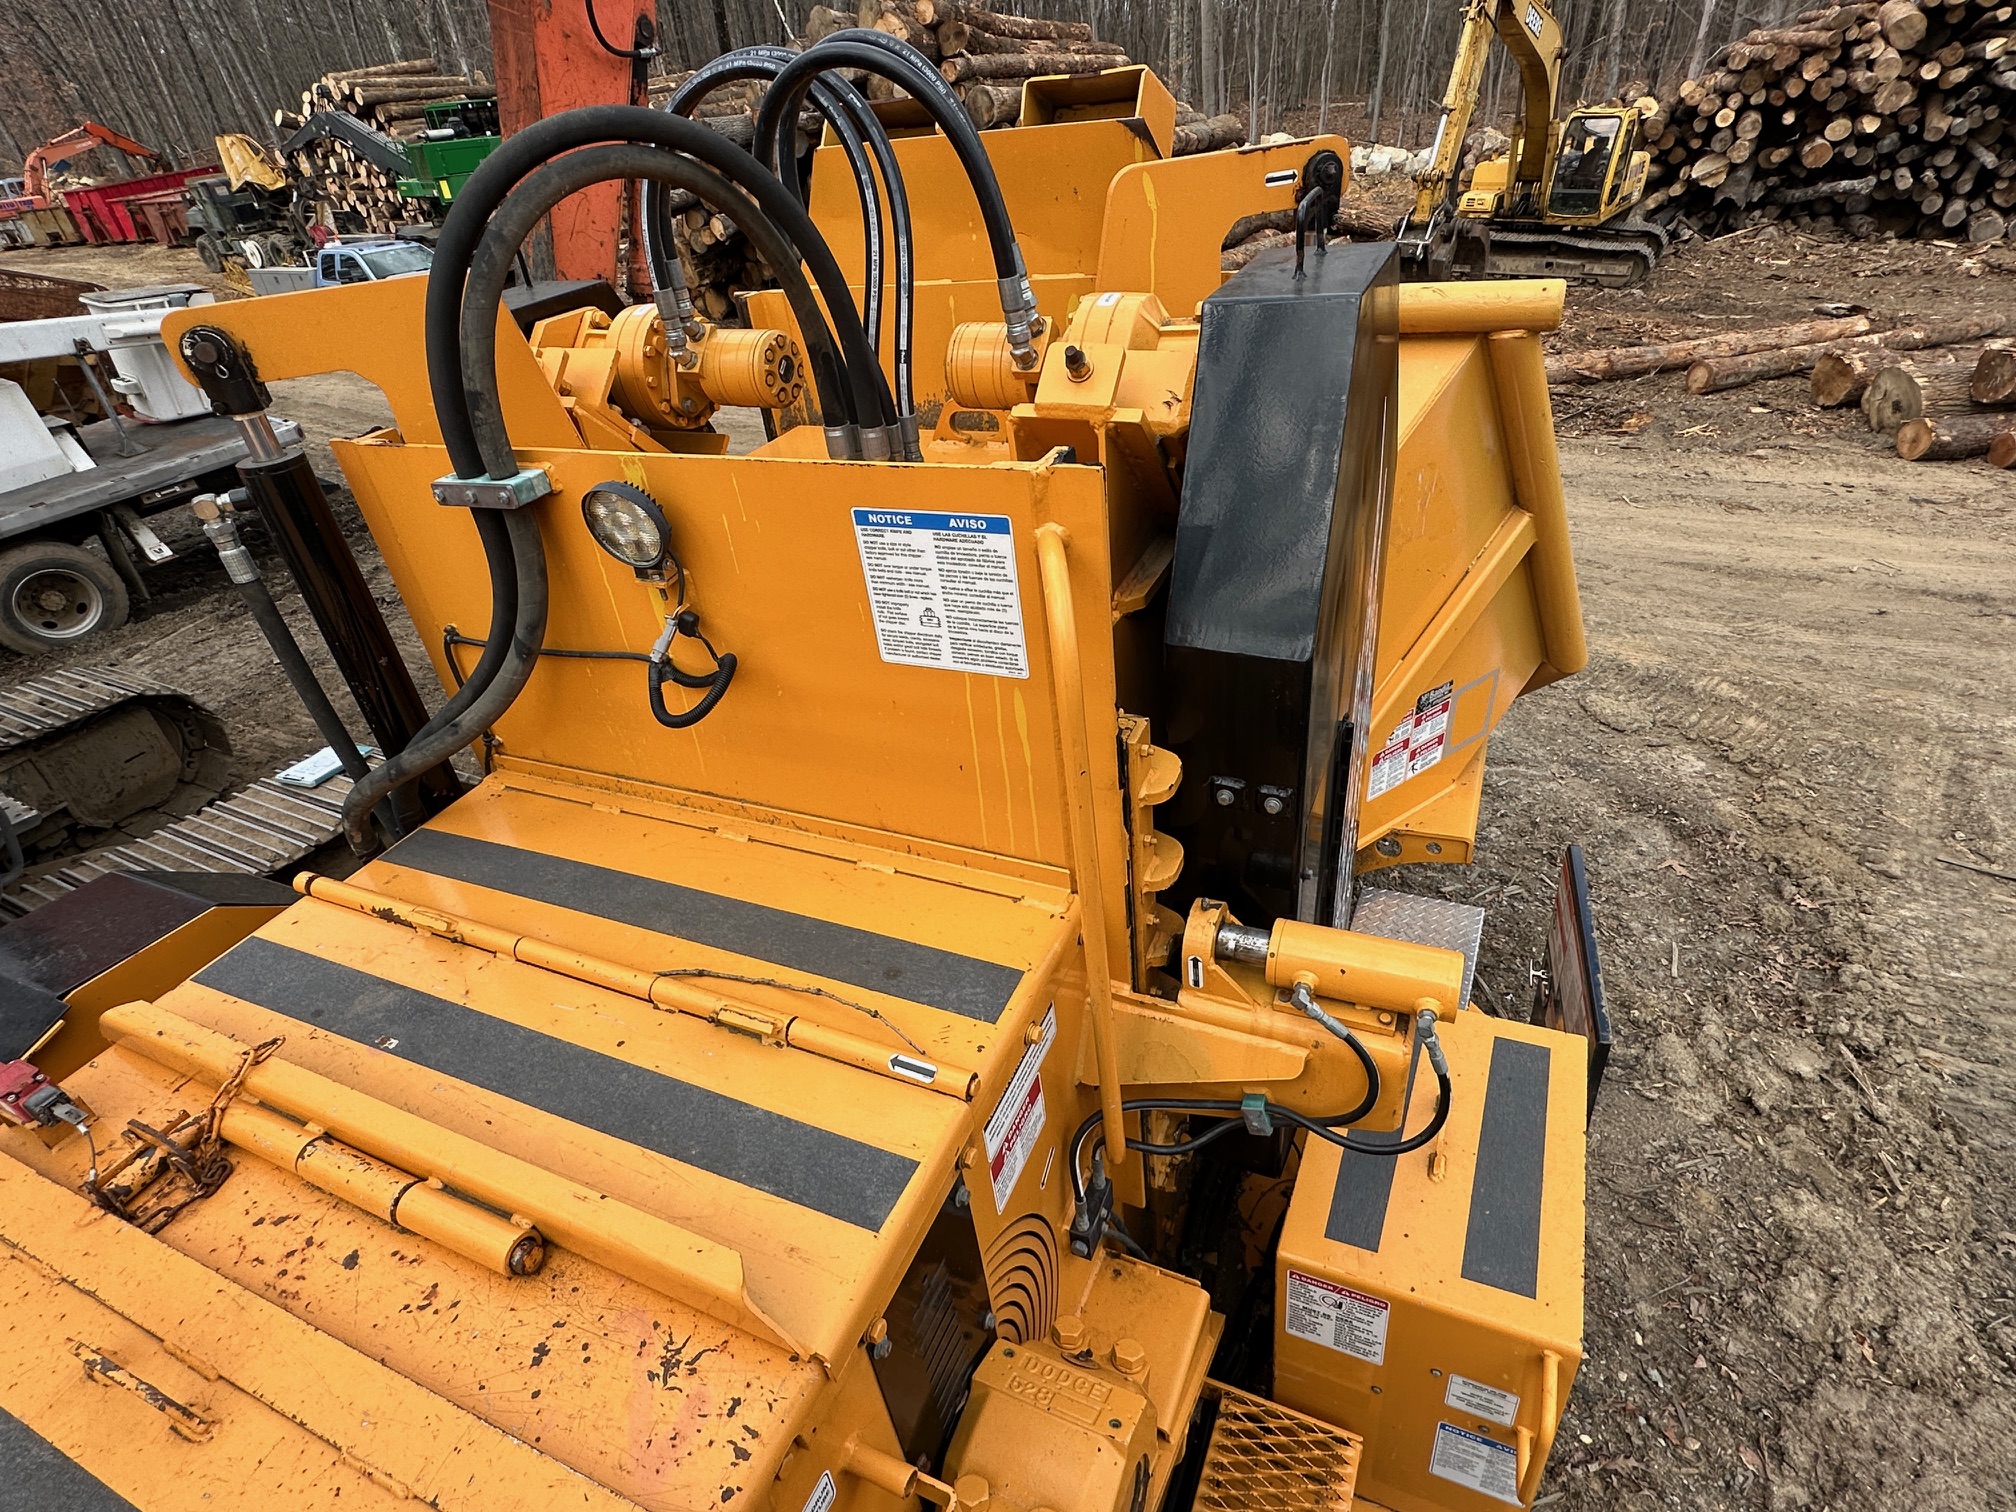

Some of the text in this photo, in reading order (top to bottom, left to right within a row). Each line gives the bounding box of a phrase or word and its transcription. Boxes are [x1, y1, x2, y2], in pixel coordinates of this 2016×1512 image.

[902, 49, 910, 57] 21
[909, 54, 923, 67] MPa
[921, 65, 937, 82] (3000
[868, 514, 912, 525] NOTICE
[948, 518, 987, 529] AVISO
[1007, 1096, 1032, 1139] DANGER
[1301, 1277, 1387, 1308] DANGER PELIGRO
[1024, 1356, 1108, 1402] DODGE
[1445, 1425, 1483, 1443] NOTICE
